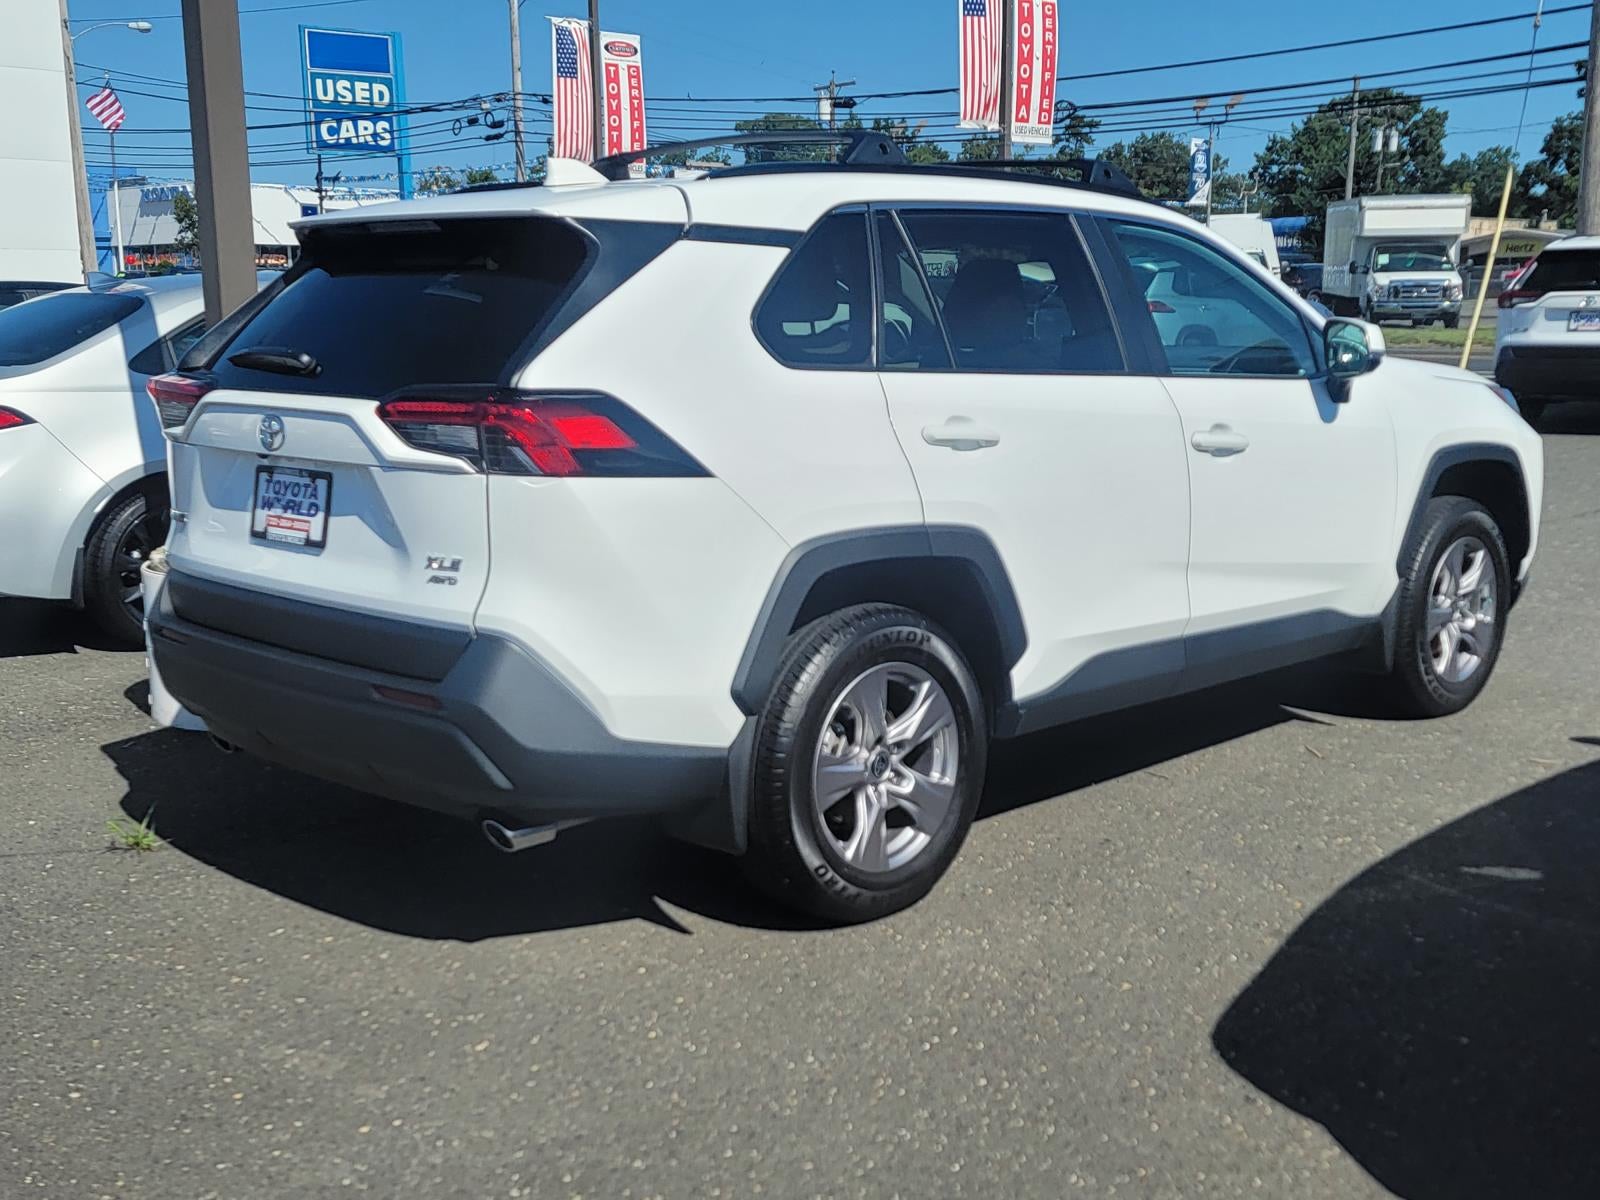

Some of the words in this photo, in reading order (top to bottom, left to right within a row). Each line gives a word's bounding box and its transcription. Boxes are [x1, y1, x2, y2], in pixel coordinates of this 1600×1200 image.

[1018, 2, 1031, 119] TOYOTA
[1041, 5, 1054, 122] CERTIFIED
[315, 78, 391, 108] USED
[608, 66, 620, 156] TOYOTA
[630, 67, 642, 151] CERTIFIE
[320, 117, 392, 147] CARS
[1014, 125, 1027, 135] USED
[1028, 126, 1050, 137] VEHICLES
[1505, 244, 1535, 253] Hertz
[264, 478, 319, 500] TOYOTA
[424, 556, 462, 572] XLE
